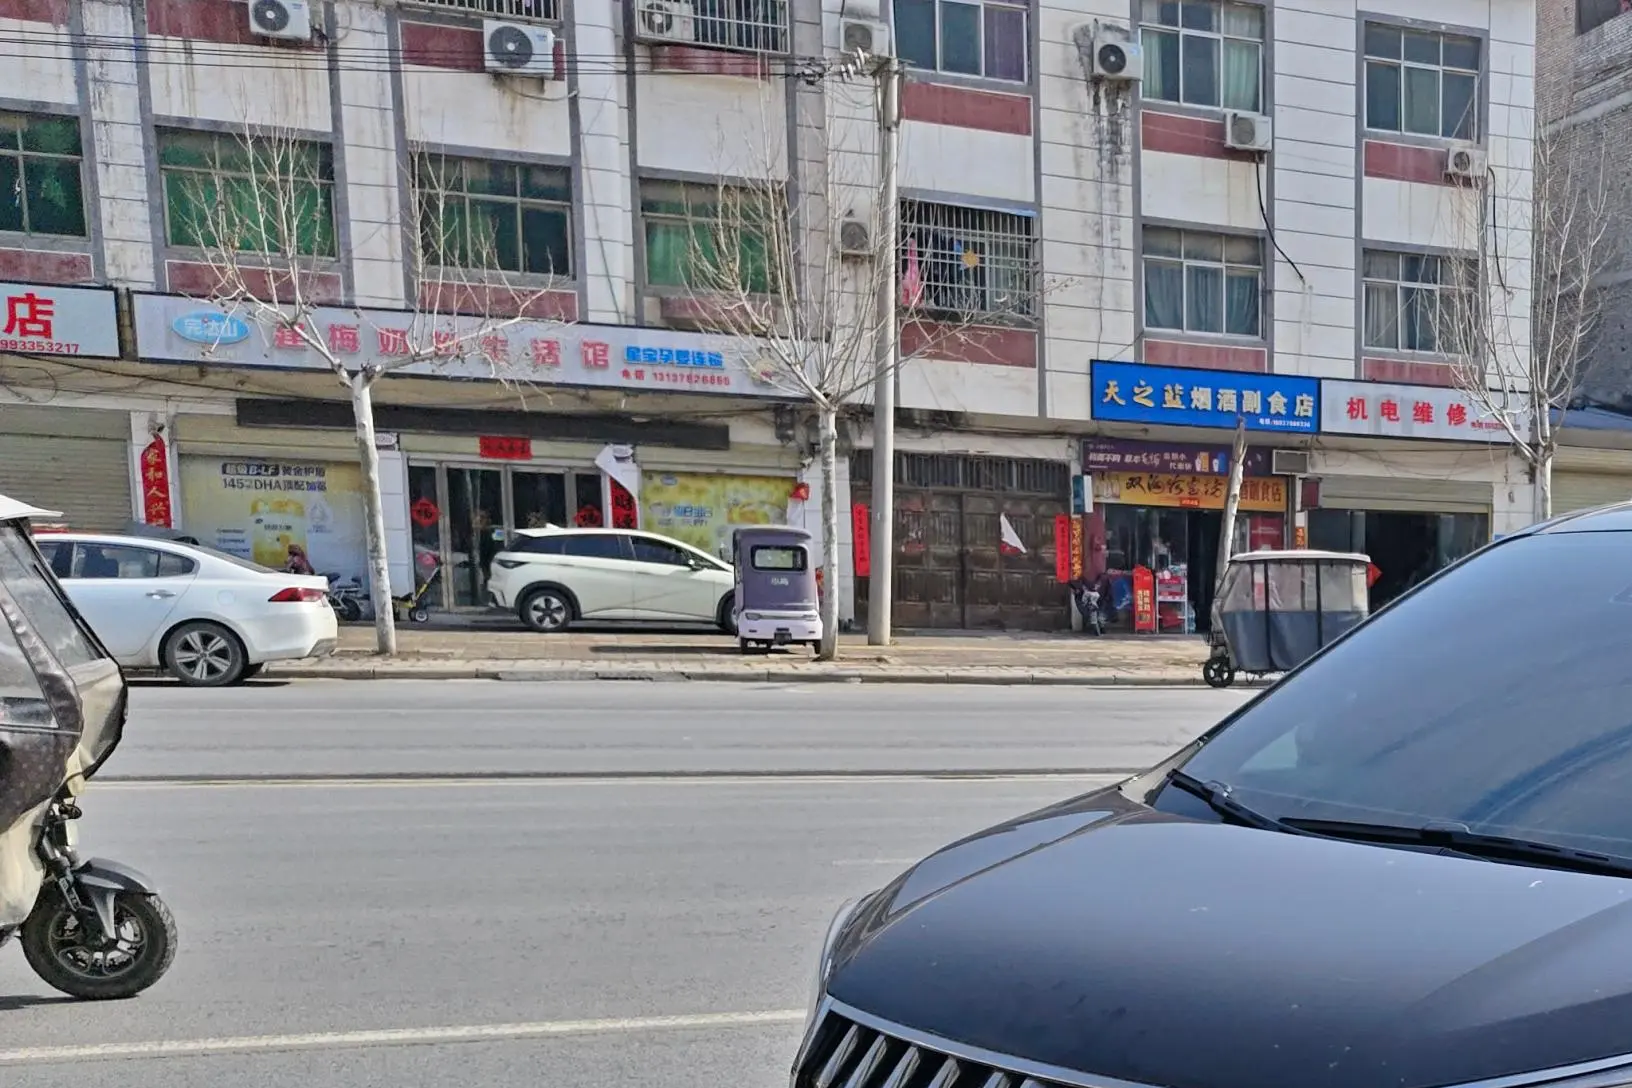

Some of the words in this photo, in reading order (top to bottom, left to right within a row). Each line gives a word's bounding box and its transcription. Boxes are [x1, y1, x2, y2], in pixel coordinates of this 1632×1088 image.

[4, 293, 54, 339] 店
[1103, 379, 1314, 417] 天之蓝烟酒副食店
[1346, 397, 1468, 426] 机电维修
